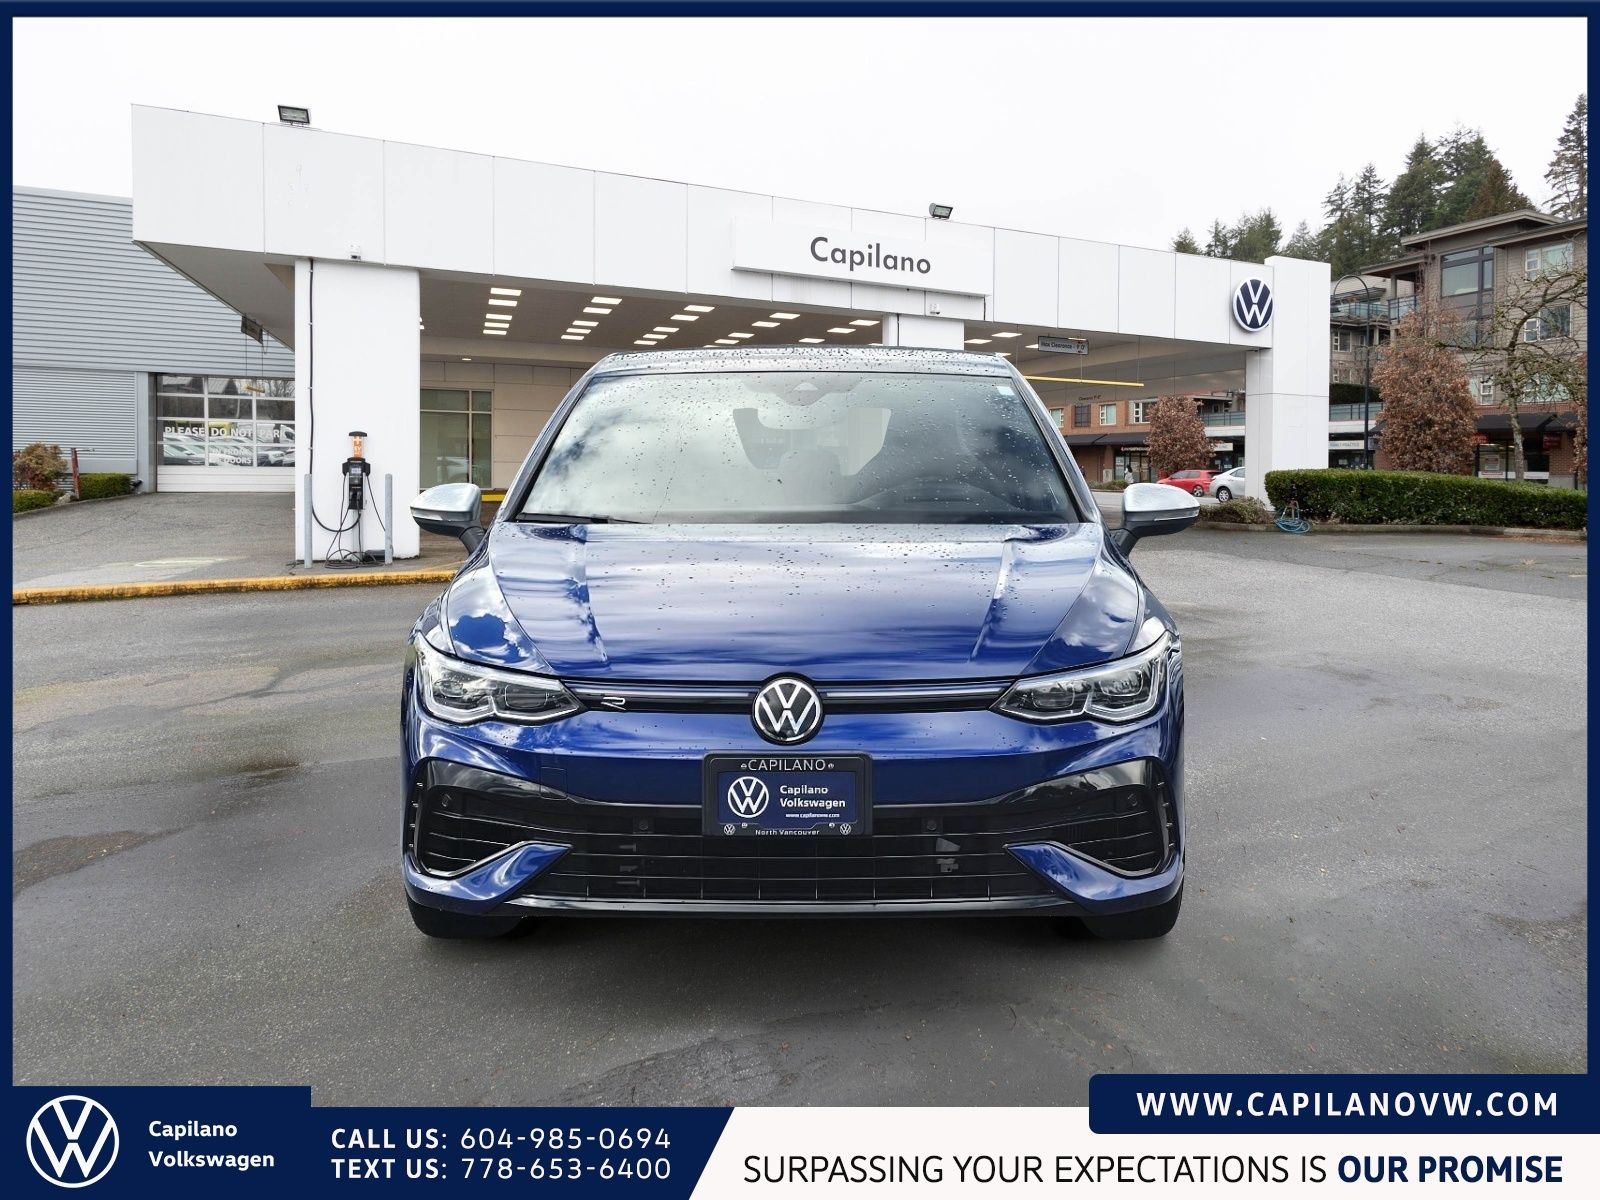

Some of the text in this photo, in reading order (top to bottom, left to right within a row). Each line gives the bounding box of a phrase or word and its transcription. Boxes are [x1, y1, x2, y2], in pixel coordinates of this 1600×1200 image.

[810, 236, 931, 275] Capilano
[1233, 277, 1273, 331] VW
[164, 426, 206, 436] PLEASE
[211, 427, 226, 436] DO
[231, 428, 253, 438] NOT
[754, 677, 822, 743] VW
[747, 759, 826, 771] CAPILANO
[727, 776, 769, 818] VW
[780, 785, 829, 796] Capilano
[780, 798, 846, 809] Volkswagen
